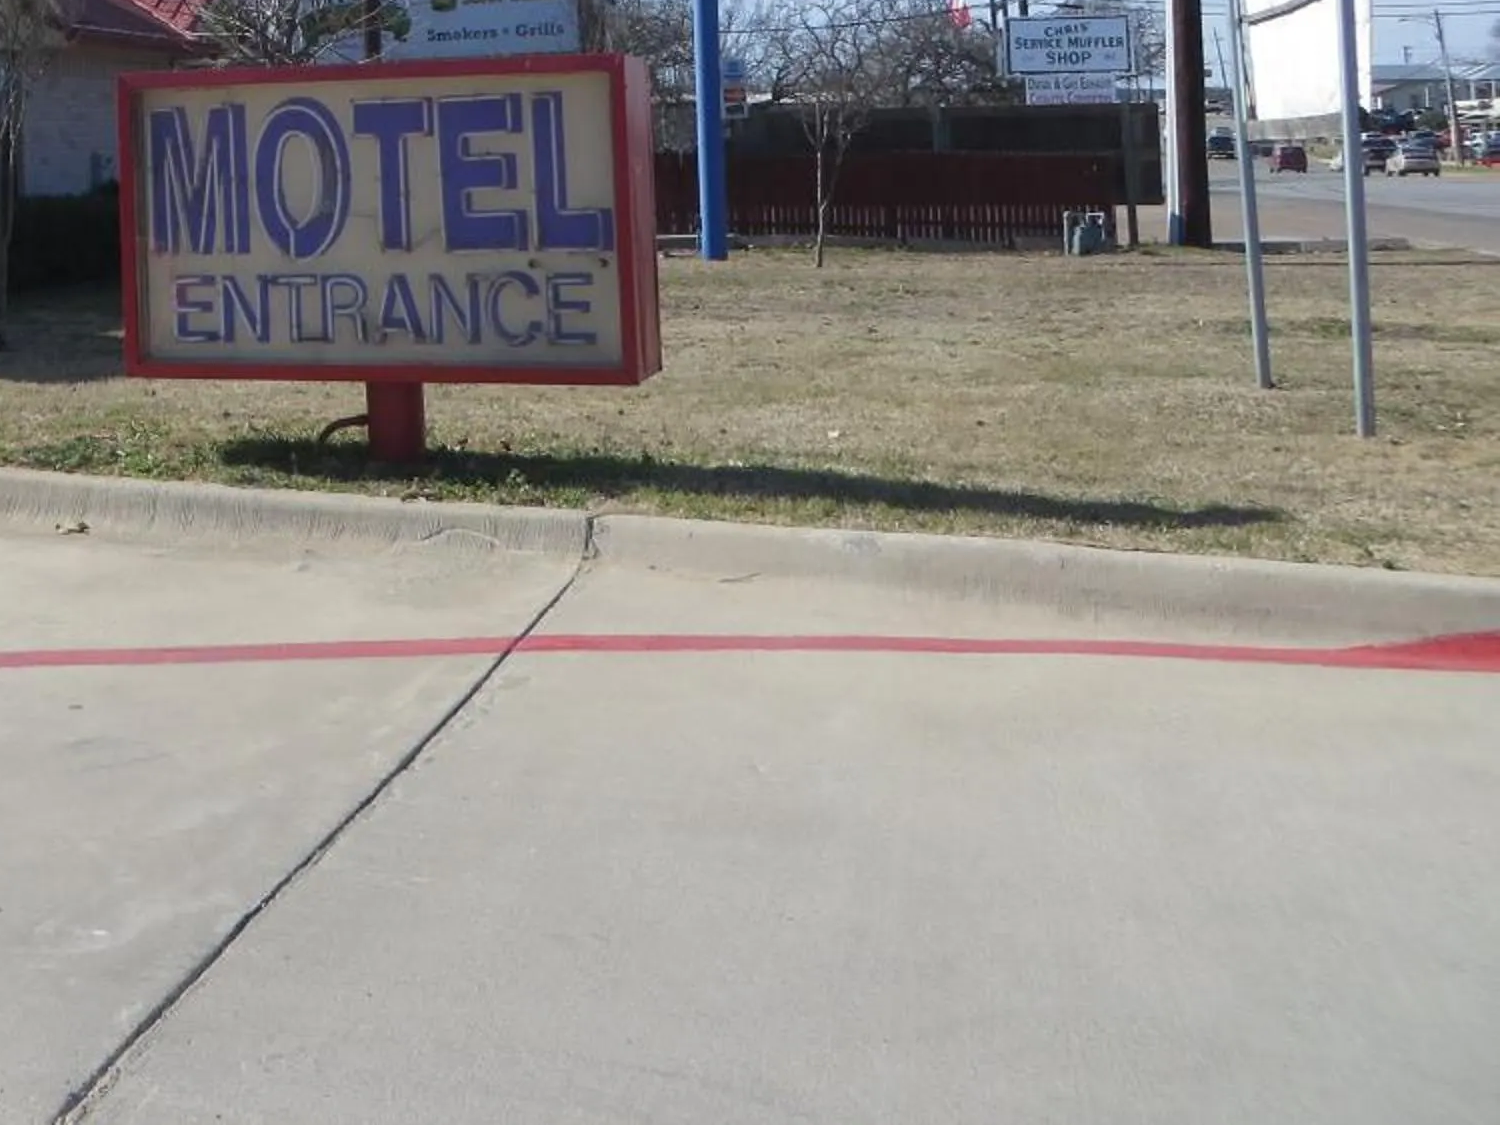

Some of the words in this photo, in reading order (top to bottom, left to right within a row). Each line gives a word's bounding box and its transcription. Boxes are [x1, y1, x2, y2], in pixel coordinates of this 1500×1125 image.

[427, 27, 499, 42] Smokers
[515, 22, 565, 38] Grills
[1068, 36, 1124, 48] MUFFLER
[1045, 50, 1093, 65] SHOP
[149, 91, 614, 259] MOTEL
[174, 269, 598, 346] ENTRANCE
